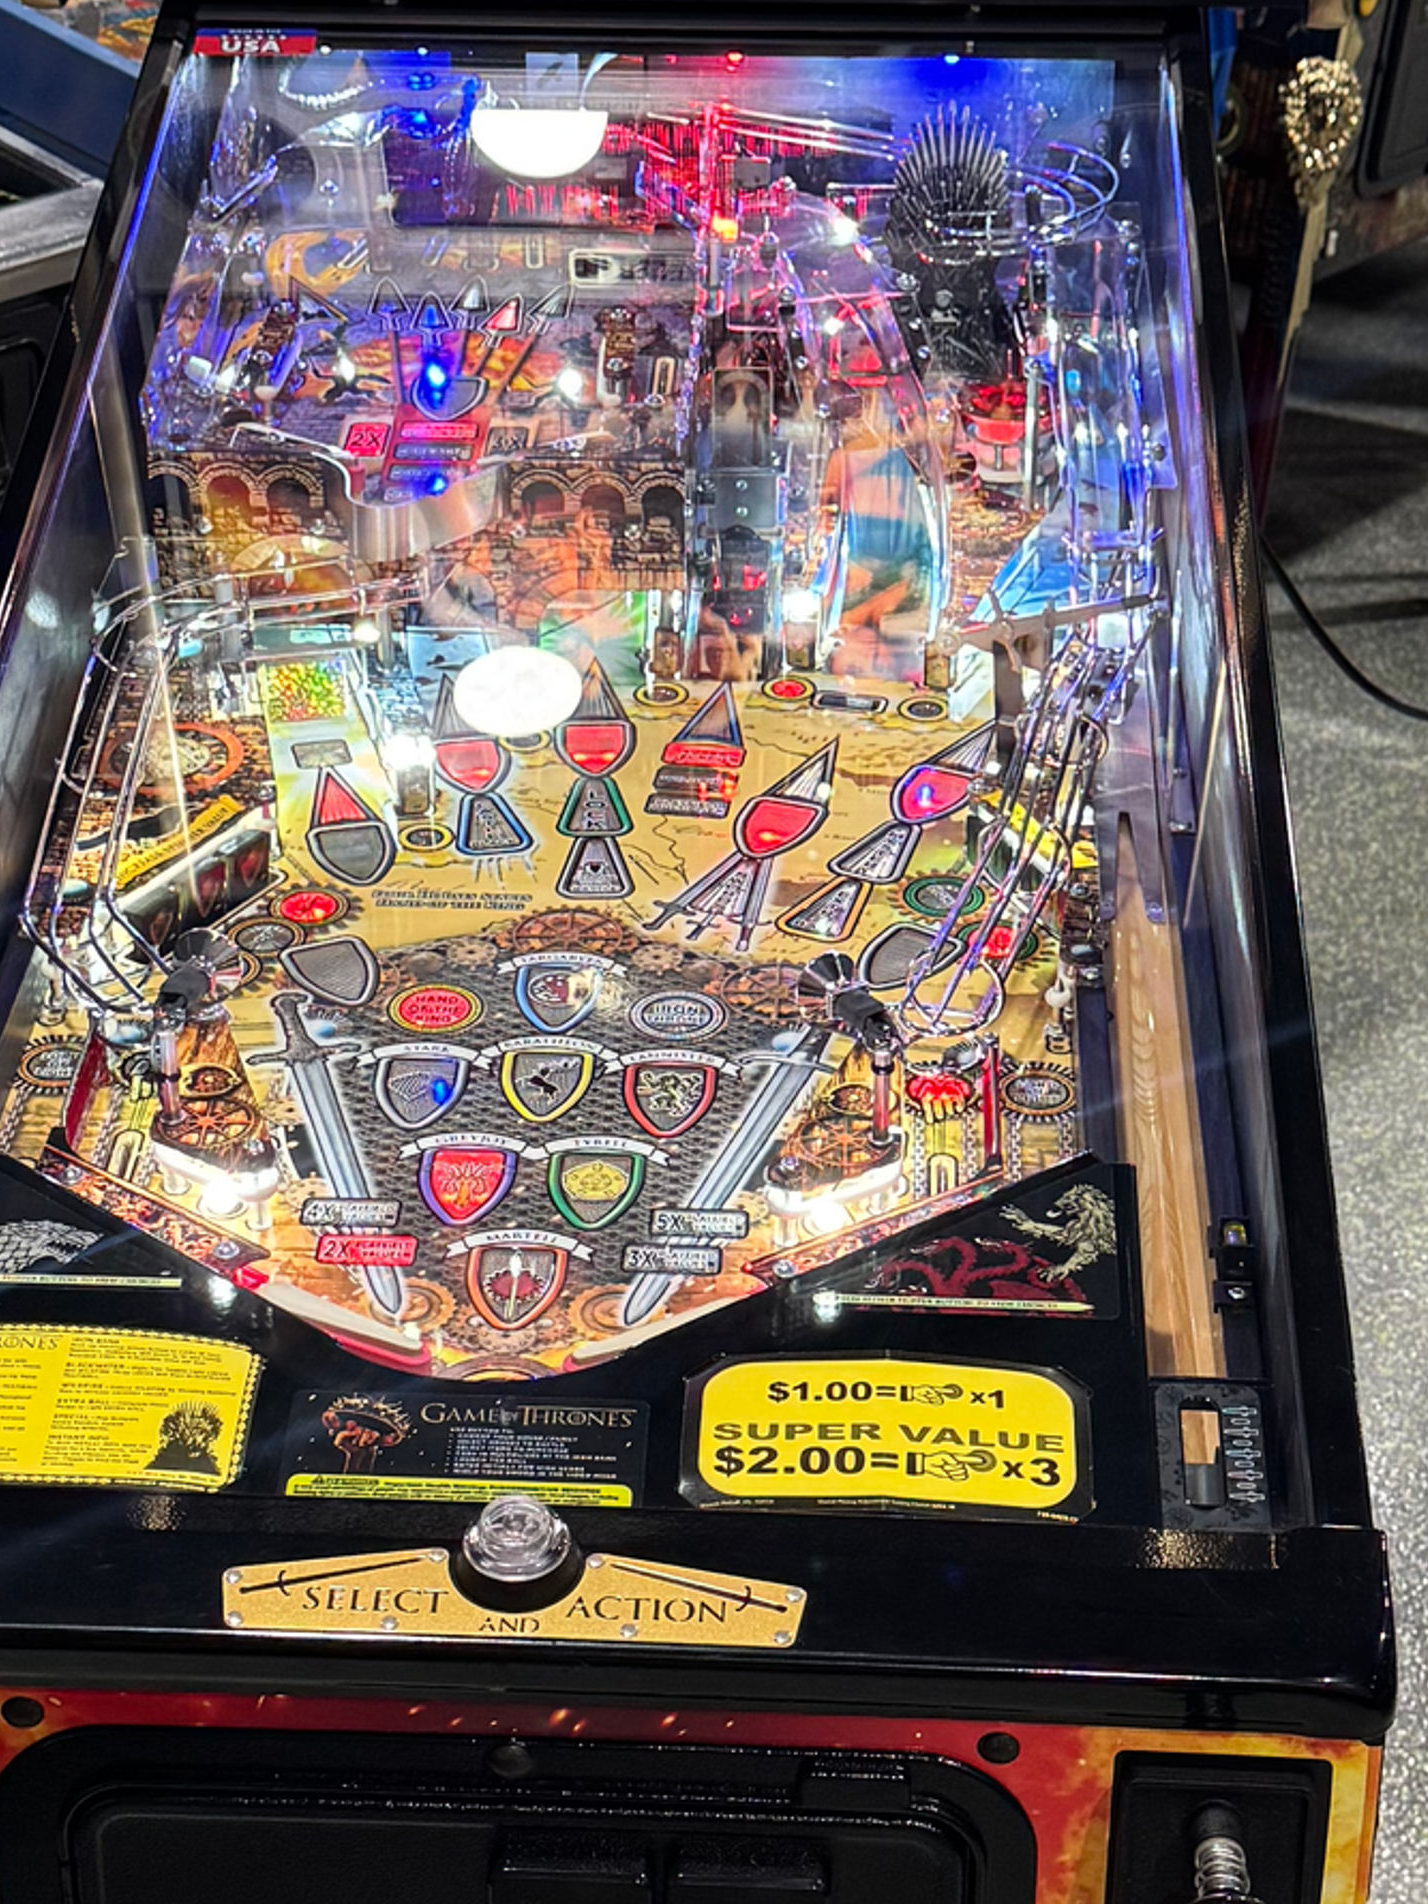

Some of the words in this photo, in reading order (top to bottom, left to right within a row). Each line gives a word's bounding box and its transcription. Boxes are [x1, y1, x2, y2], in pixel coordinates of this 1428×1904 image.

[220, 39, 281, 53] USA
[415, 994, 459, 1004] HAND
[416, 1014, 452, 1024] KING
[656, 1213, 682, 1231] 5X
[323, 1239, 351, 1258] 2X
[628, 1250, 654, 1268] 3X
[420, 1402, 499, 1427] GAME
[518, 1404, 637, 1428] THRONES
[713, 1423, 882, 1441] SUPER
[899, 1424, 1065, 1454] VALUE
[302, 1585, 449, 1615] SELECT
[566, 1596, 732, 1625] ACTION
[478, 1615, 540, 1634] AND
